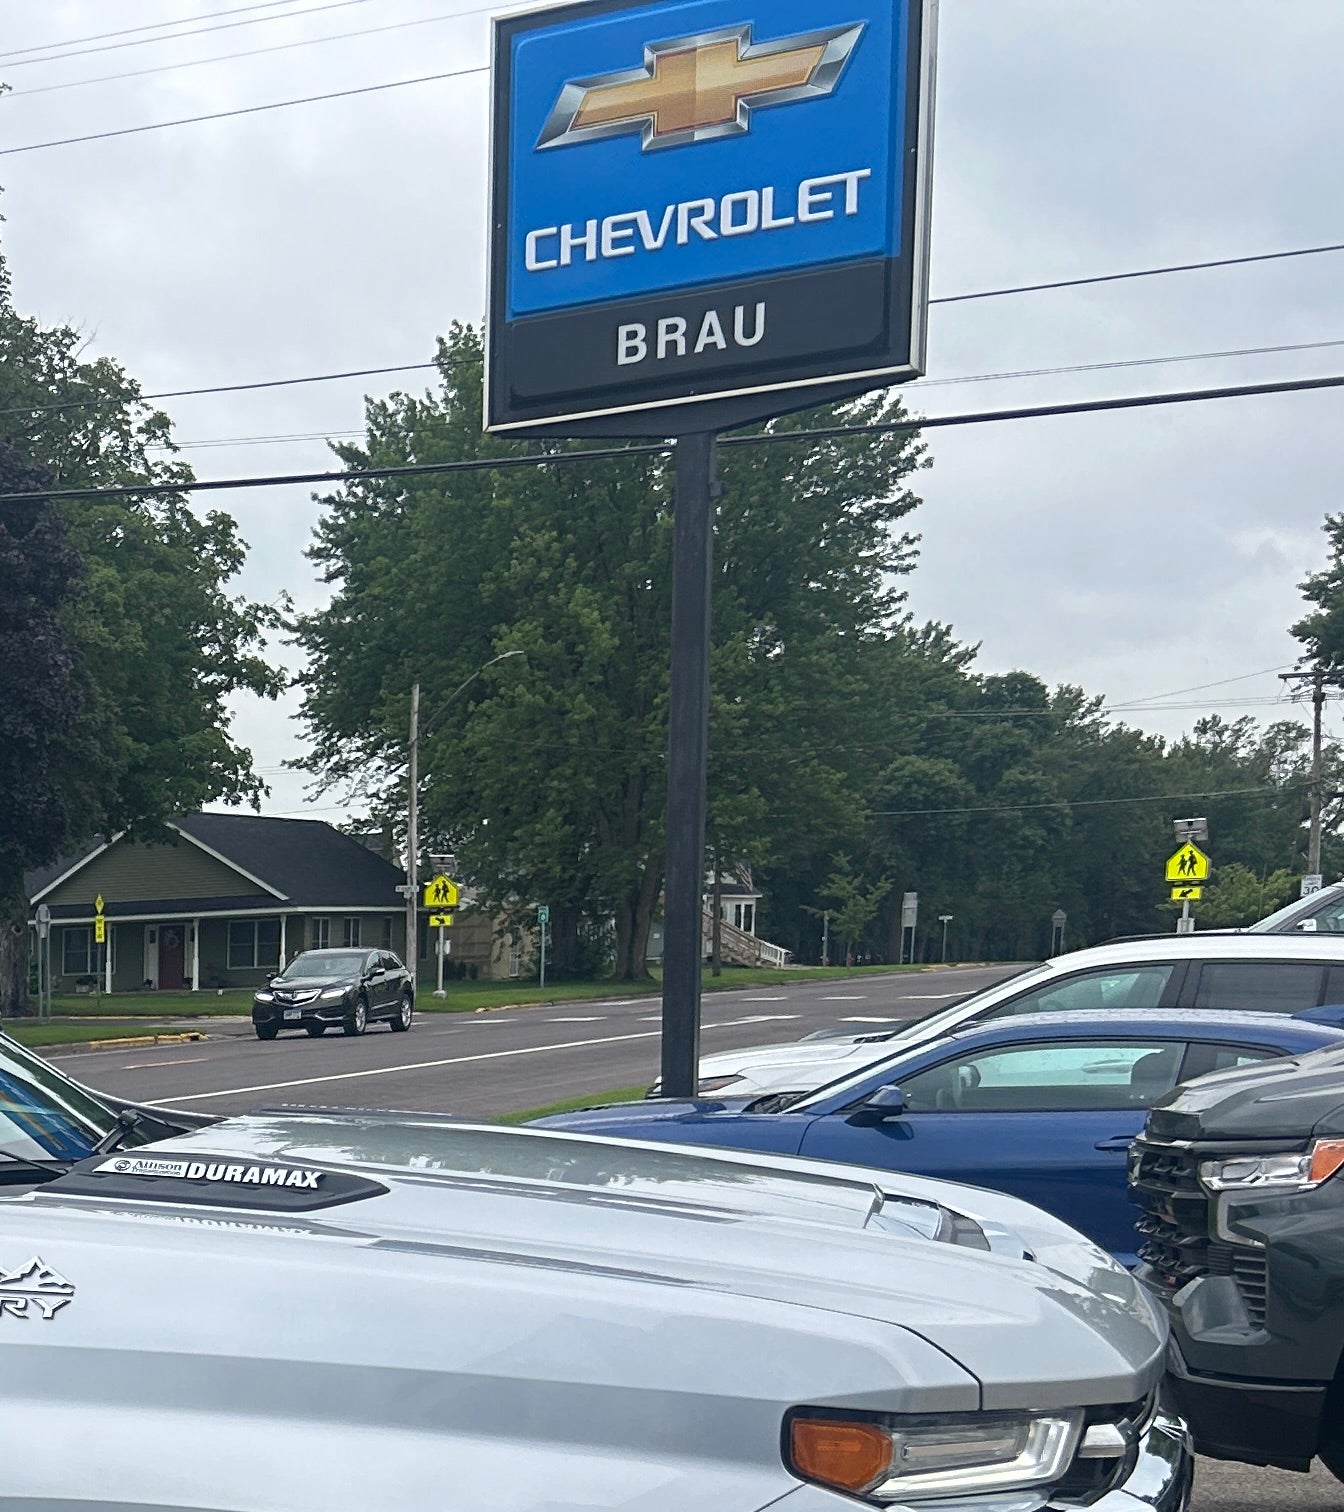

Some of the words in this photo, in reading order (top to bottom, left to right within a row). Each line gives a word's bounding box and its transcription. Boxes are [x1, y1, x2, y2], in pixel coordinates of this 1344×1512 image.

[525, 168, 871, 271] CHEVROLET
[617, 302, 765, 366] BRAU
[134, 1160, 182, 1171] Allison
[186, 1162, 324, 1190] DURAMAX
